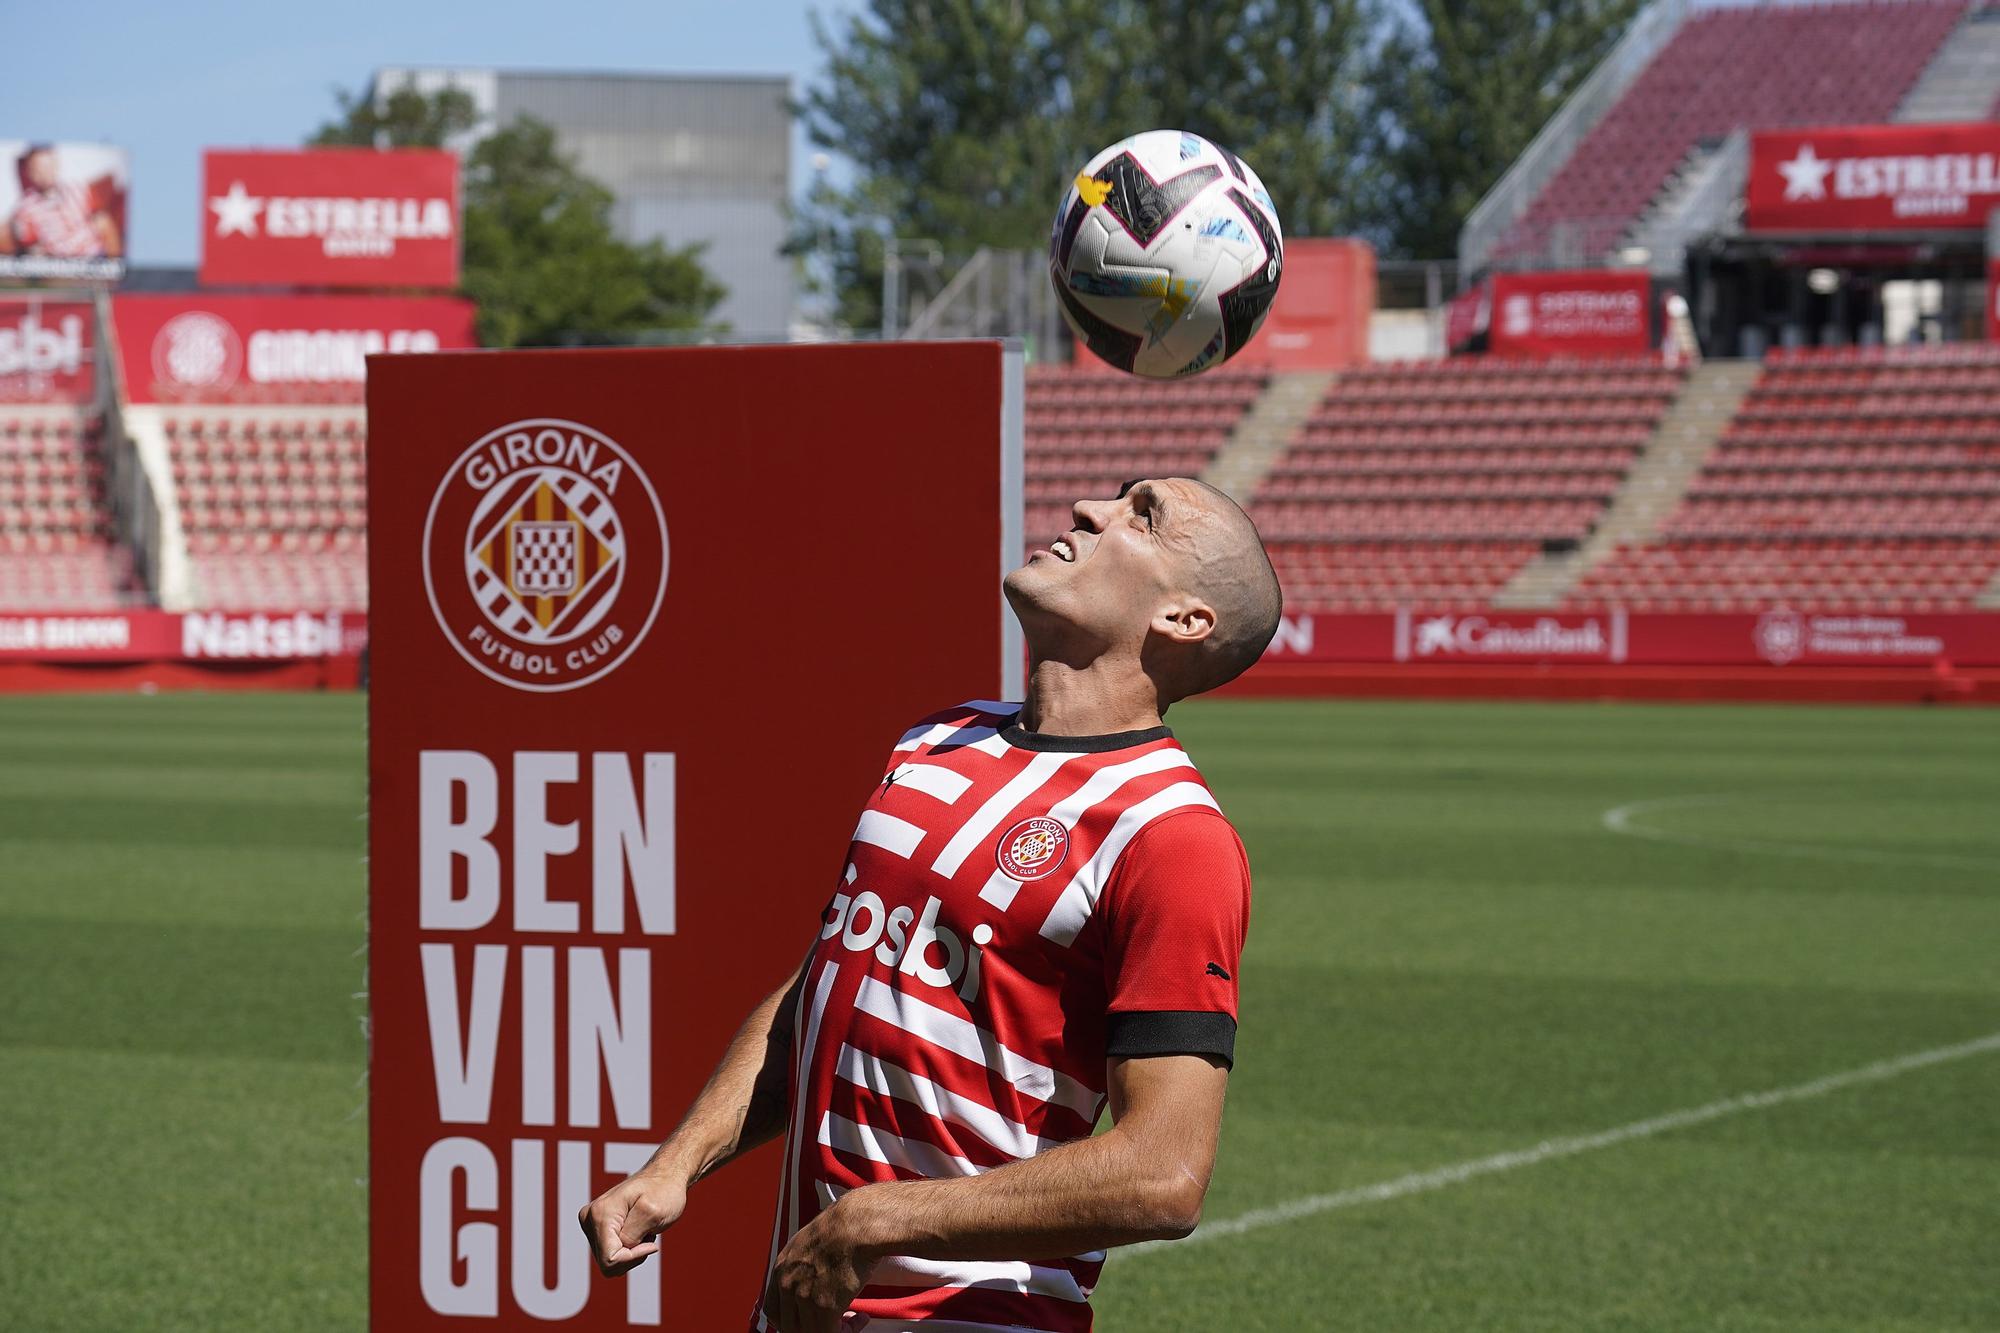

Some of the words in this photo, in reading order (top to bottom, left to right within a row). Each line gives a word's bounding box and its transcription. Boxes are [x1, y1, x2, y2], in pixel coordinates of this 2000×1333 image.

[1836, 153, 2000, 198] ESTRELL
[266, 198, 451, 239] ESTRELLA
[465, 429, 623, 496] GIRONA
[182, 611, 341, 658] Natsbi
[468, 624, 558, 674] FUTBOL
[566, 624, 624, 669] CLUB
[1455, 615, 1606, 654] CaixaBank
[419, 749, 676, 935] BEN
[1030, 820, 1064, 845] GIRONA
[1004, 852, 1018, 872] FUTBOL
[420, 943, 651, 1130] VIN
